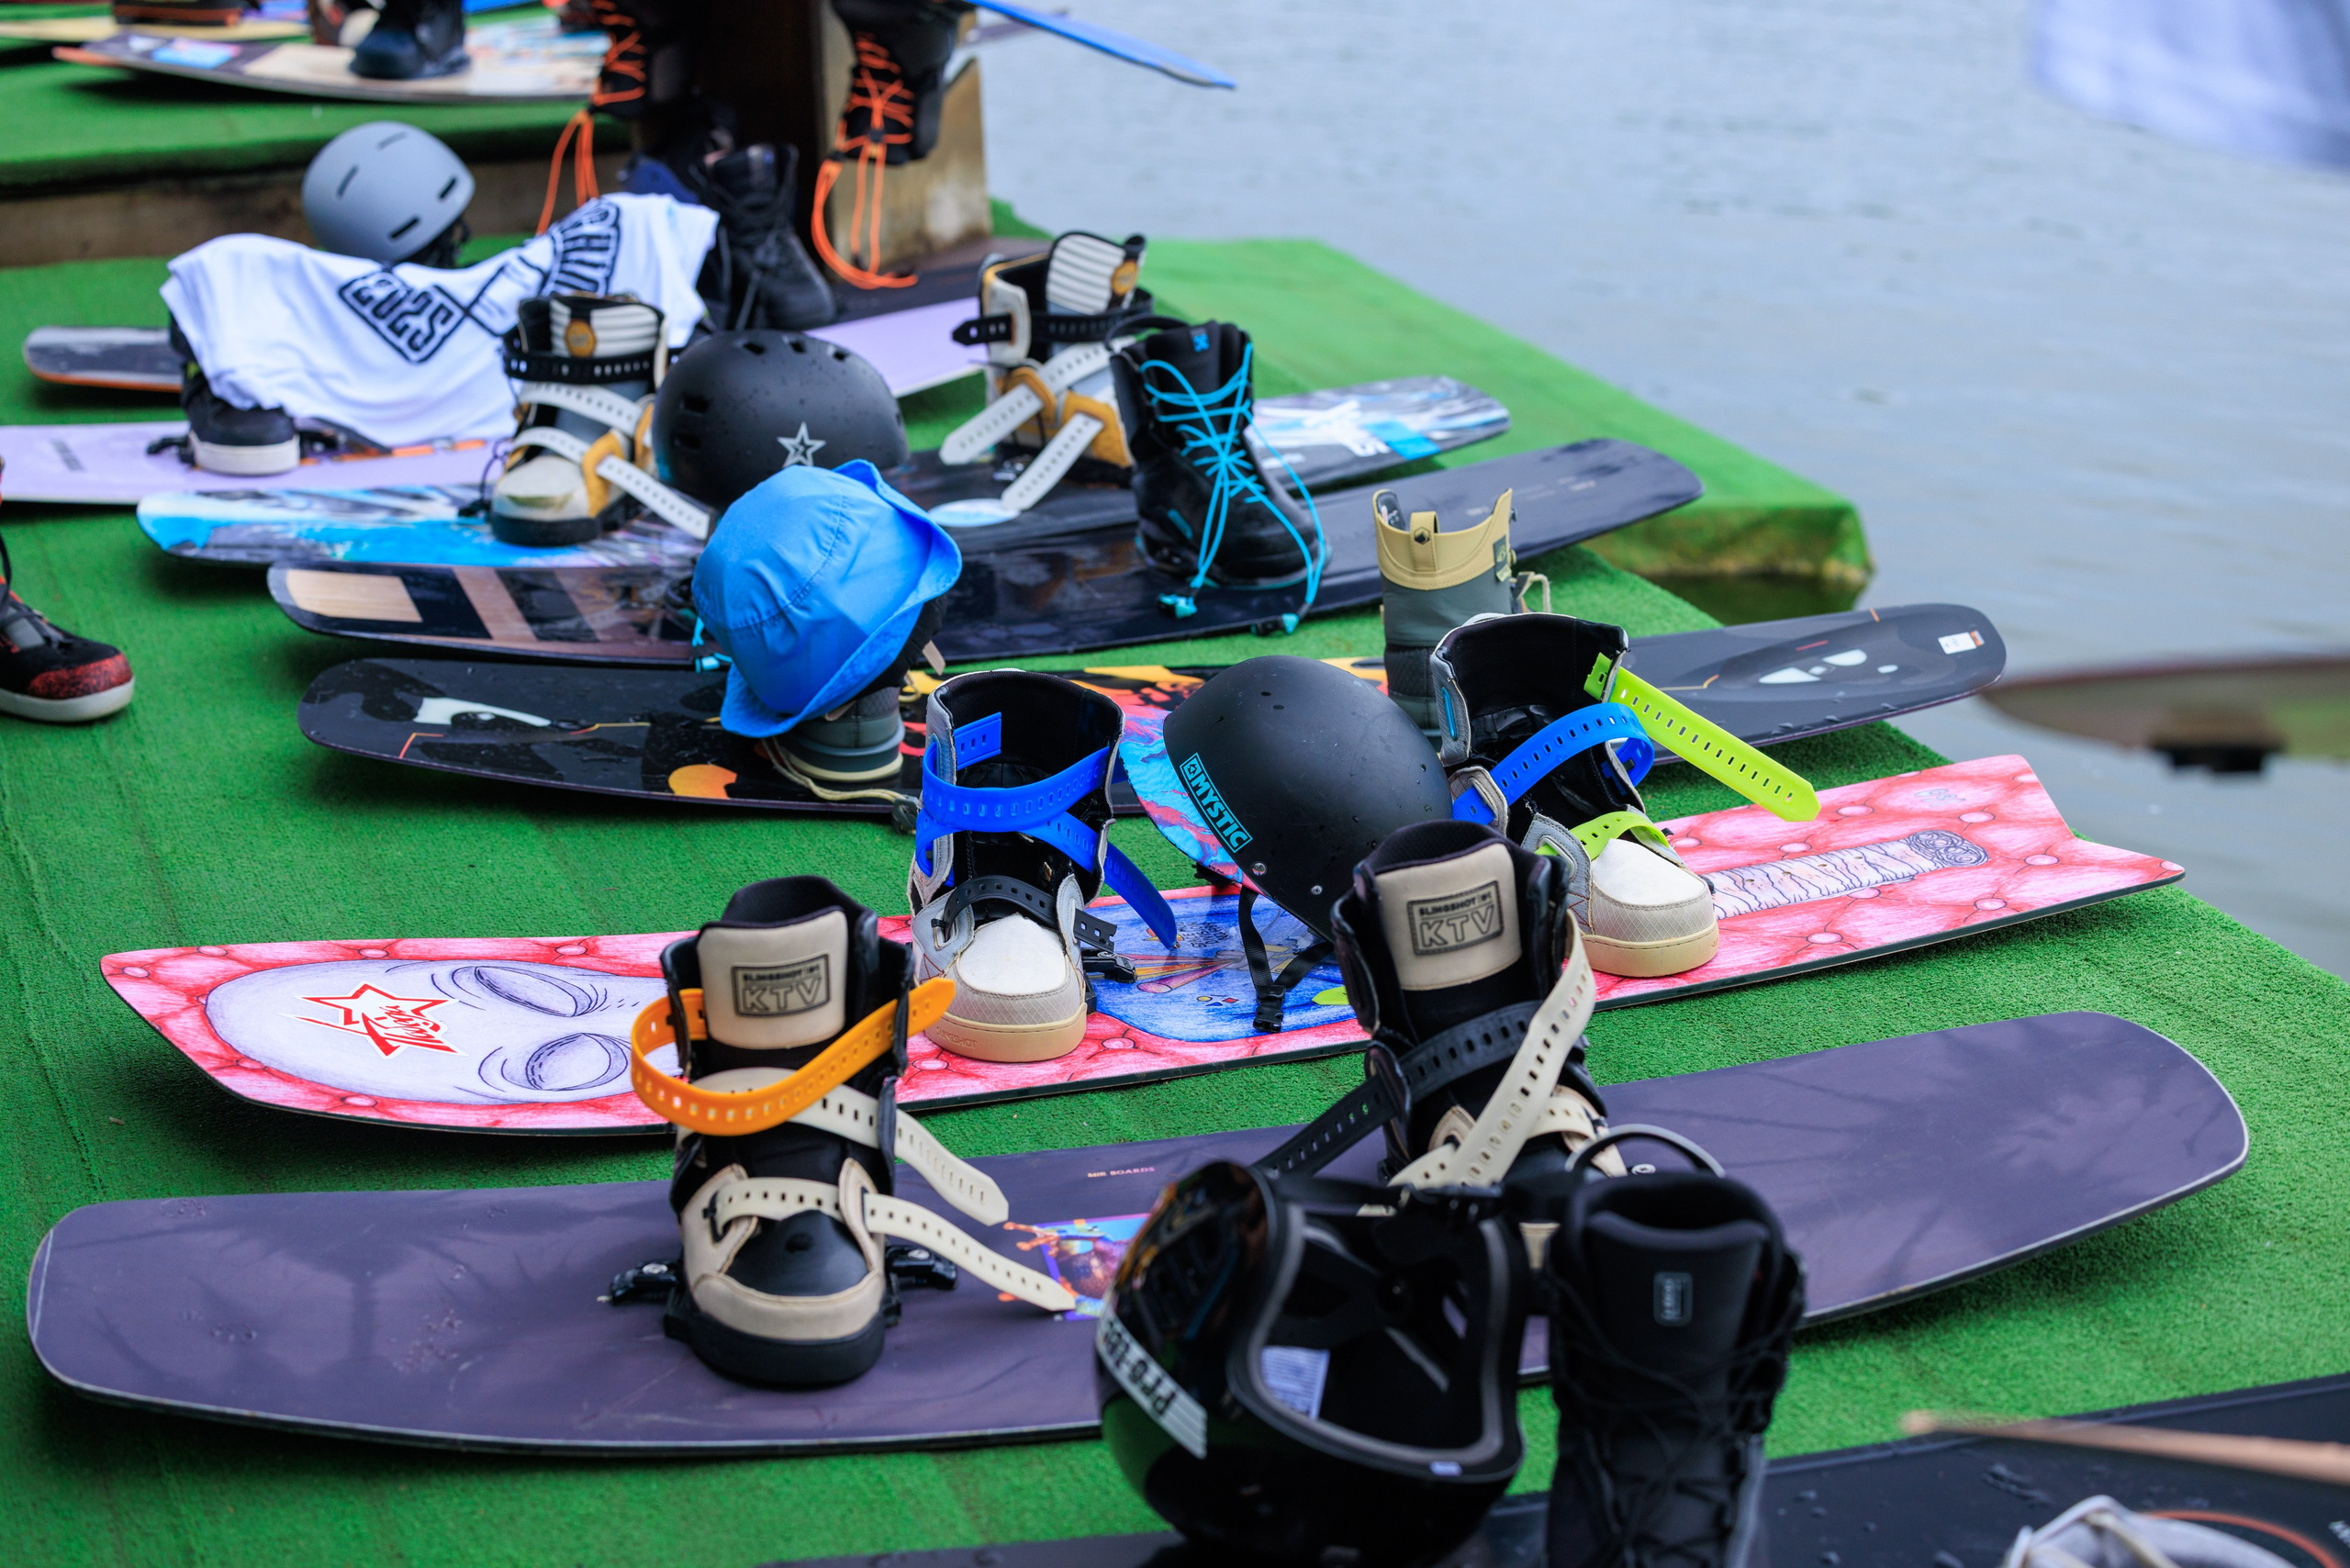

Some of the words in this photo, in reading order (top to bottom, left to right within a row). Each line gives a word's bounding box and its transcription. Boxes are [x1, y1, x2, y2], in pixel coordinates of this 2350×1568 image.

[1190, 772, 1249, 848] MYSTIC
[1419, 904, 1494, 948] KTV
[742, 977, 822, 1011] KTV
[1109, 1166, 1155, 1176] BOARDS
